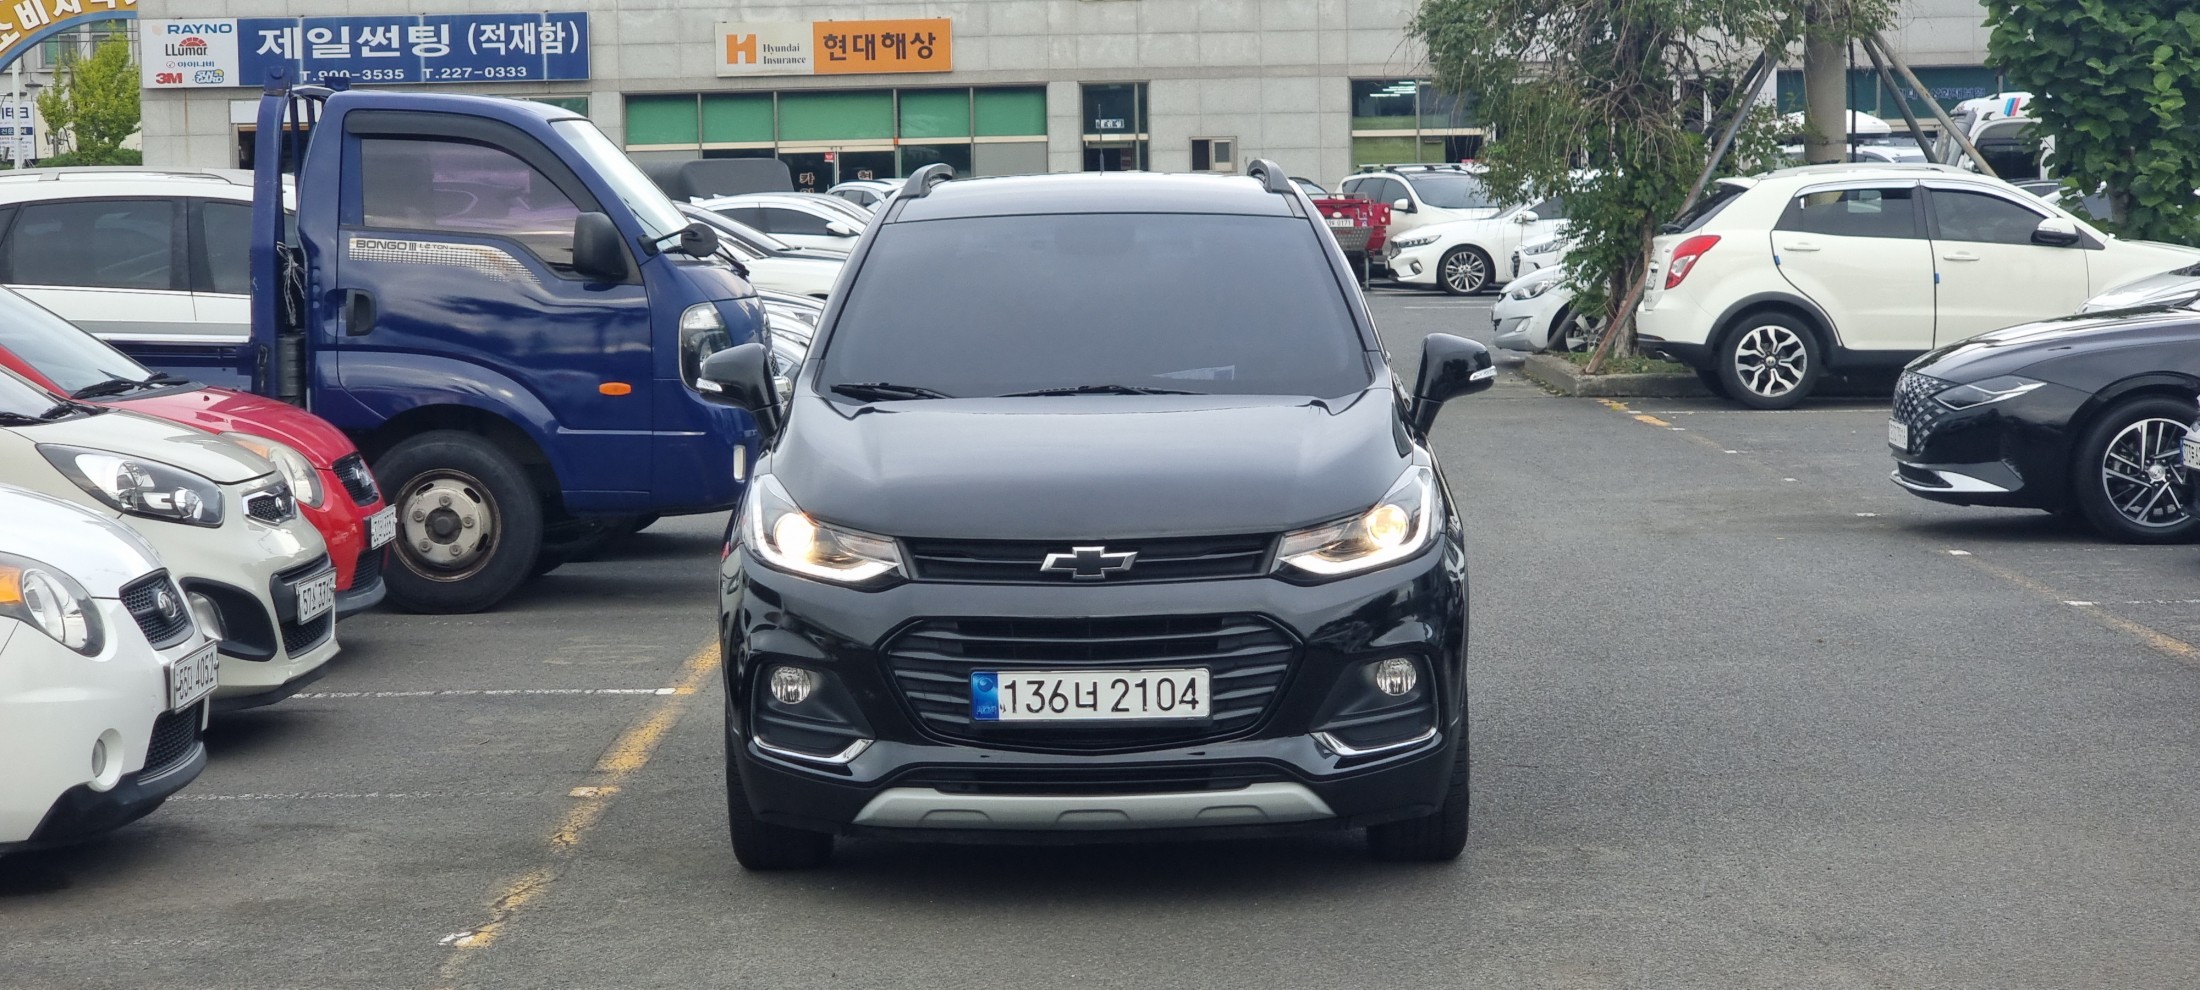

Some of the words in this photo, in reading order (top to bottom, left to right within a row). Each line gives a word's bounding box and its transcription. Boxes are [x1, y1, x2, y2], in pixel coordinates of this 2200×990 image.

[167, 23, 233, 35] RAYNO
[256, 24, 451, 60] 제일썬팅
[467, 20, 580, 55] (적재함)
[823, 32, 937, 61] 현대해상
[165, 43, 208, 57] LLumar
[763, 43, 800, 55] Hyundai
[178, 60, 215, 68] 아이나비
[763, 55, 807, 65] Insurance
[156, 72, 183, 84] 3M
[423, 66, 527, 80] T.227-0333
[356, 239, 407, 251] BONGO
[196, 652, 214, 690] 4052
[1004, 679, 1099, 714] 136너
[1110, 677, 1200, 713] 2104
